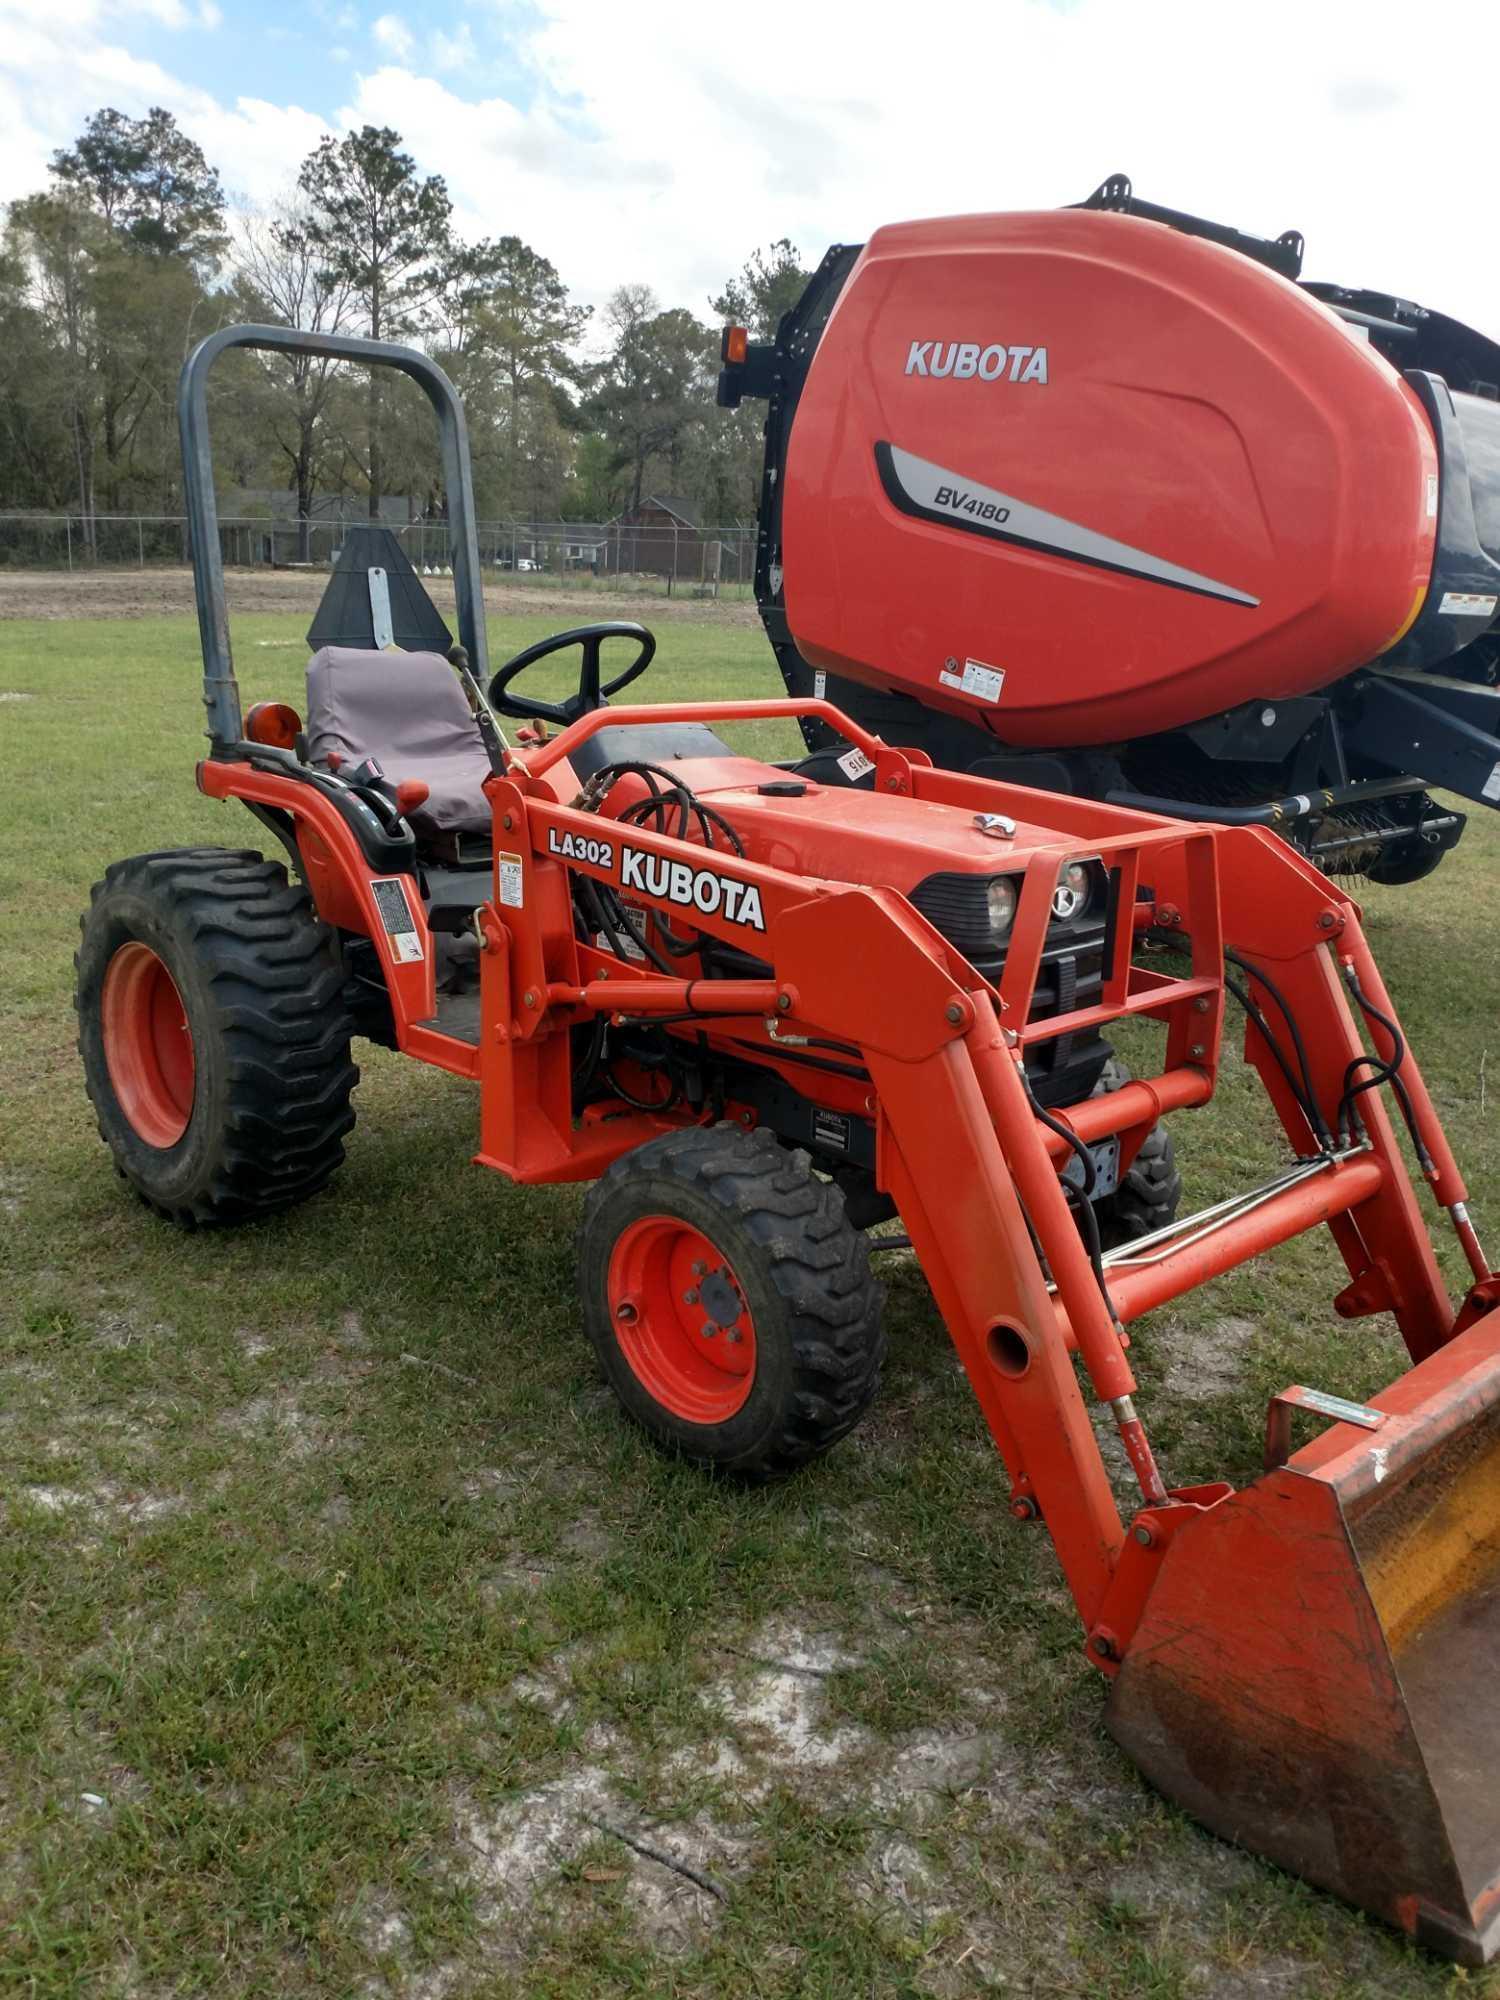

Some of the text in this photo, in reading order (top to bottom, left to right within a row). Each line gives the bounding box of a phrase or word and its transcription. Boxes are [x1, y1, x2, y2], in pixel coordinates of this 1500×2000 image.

[904, 341, 1049, 385] KUBOTA
[934, 486, 1011, 523] BV4180
[549, 828, 765, 931] LA302 KUBOTA
